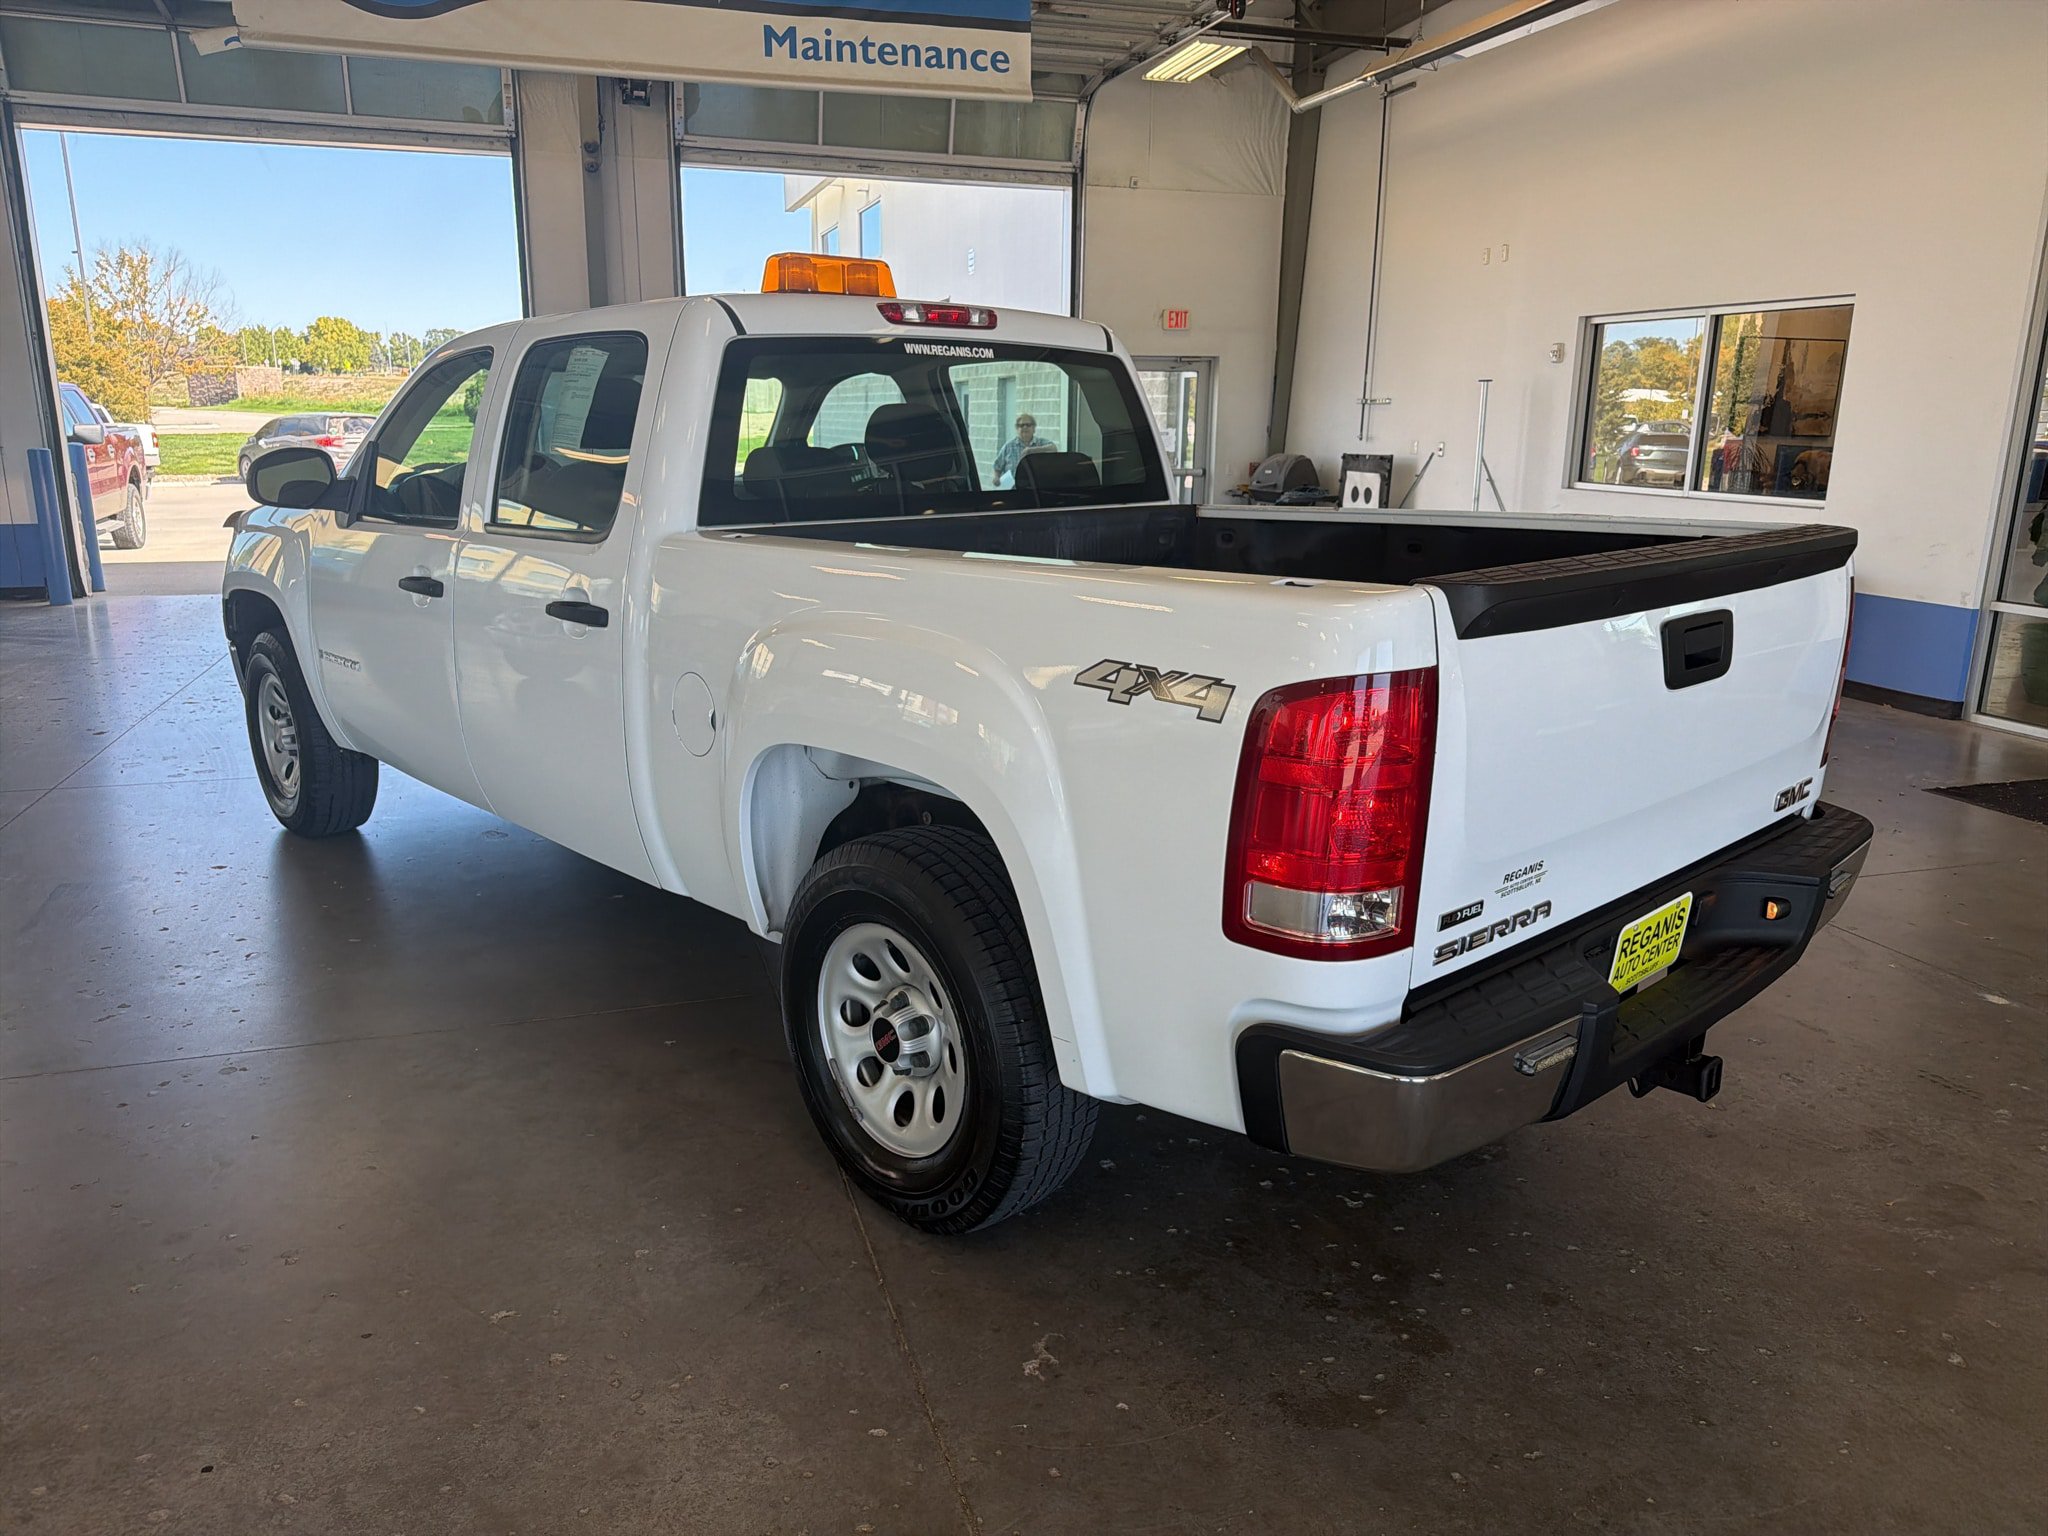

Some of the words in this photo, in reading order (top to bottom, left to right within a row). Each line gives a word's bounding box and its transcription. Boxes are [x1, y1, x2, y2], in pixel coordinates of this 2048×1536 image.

[763, 24, 1010, 73] Maintenance
[1168, 310, 1189, 329] EXIT
[903, 343, 995, 359] WWW.REGANIS.COM
[1773, 777, 1814, 812] GMC
[1503, 860, 1544, 885] REGANIS
[1432, 900, 1552, 967] SIERRA
[1618, 907, 1686, 962] REGANIS
[1611, 954, 1640, 984] AUTO
[1641, 932, 1680, 966] CENTER
